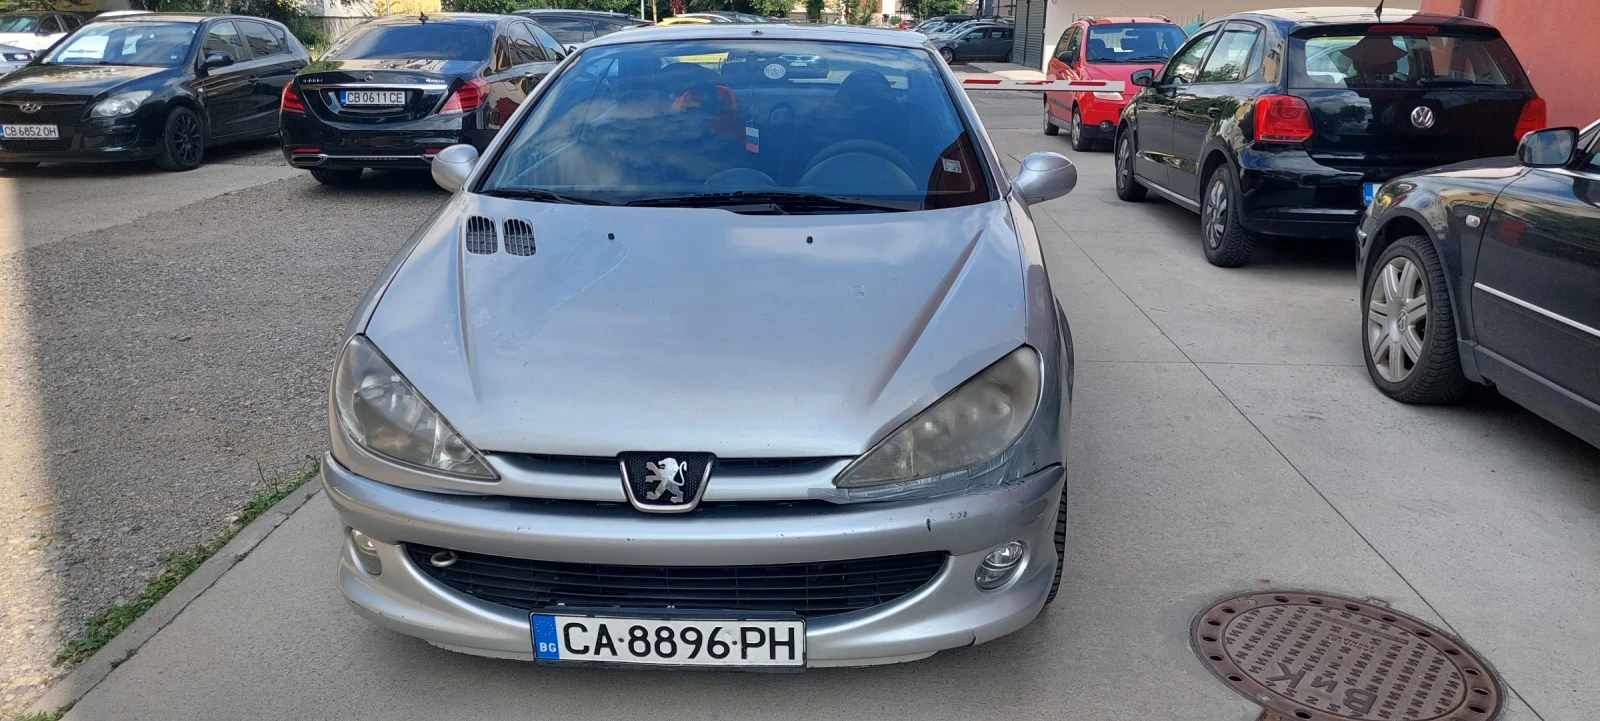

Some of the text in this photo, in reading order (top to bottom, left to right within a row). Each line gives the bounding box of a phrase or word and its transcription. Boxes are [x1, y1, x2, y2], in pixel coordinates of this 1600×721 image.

[347, 92, 361, 103] CB
[362, 92, 387, 103] 0611
[389, 92, 403, 103] CE
[4, 126, 57, 137] CB 6852 OH
[562, 622, 796, 660] CA 8896 PH
[539, 642, 557, 653] BG
